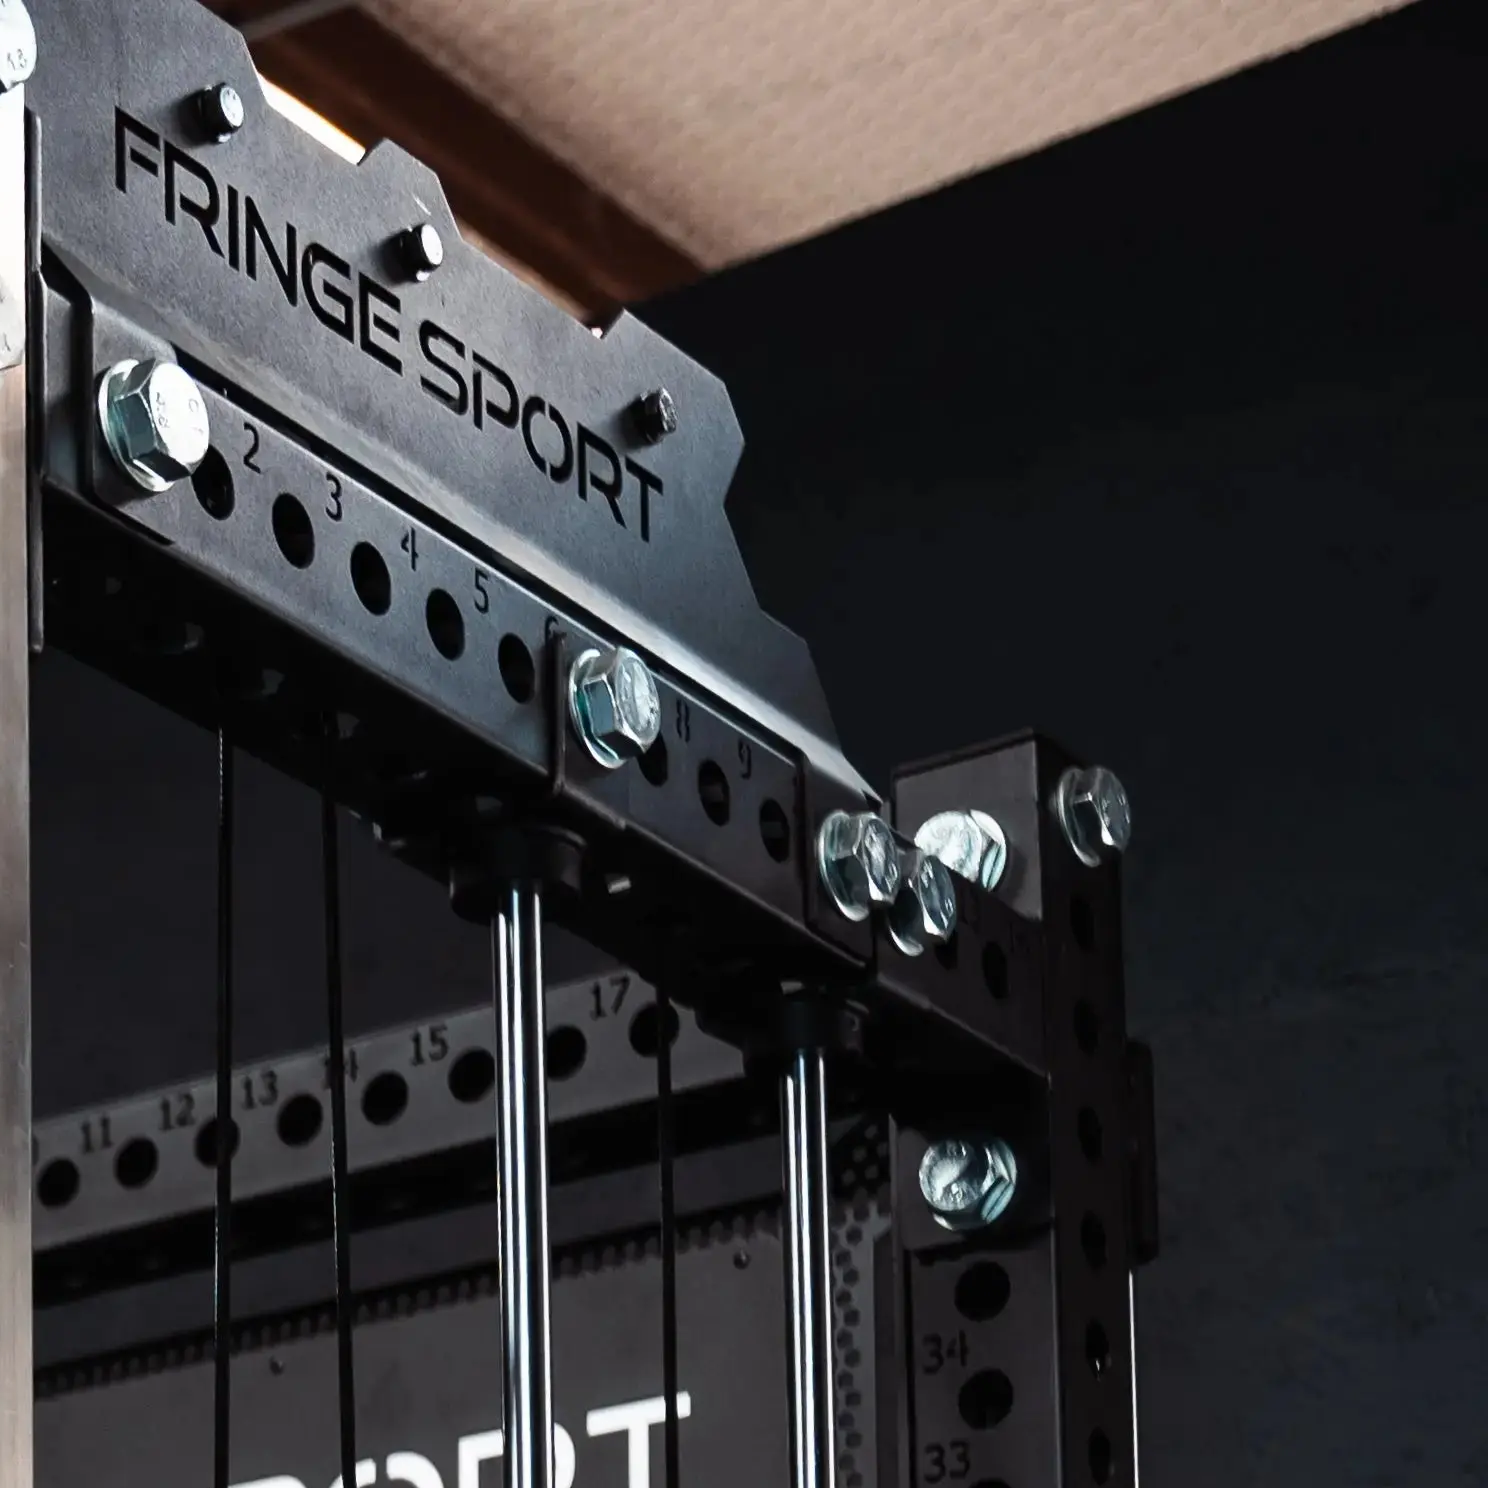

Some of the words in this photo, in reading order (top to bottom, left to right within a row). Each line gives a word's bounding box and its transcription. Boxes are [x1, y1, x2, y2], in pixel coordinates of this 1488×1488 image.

[115, 107, 403, 374] FRINGE
[419, 324, 663, 541] SPORT
[244, 424, 261, 474] 2
[325, 477, 343, 522] 3
[400, 528, 419, 571] 4
[475, 569, 489, 613] 5
[589, 976, 630, 1019] 17
[410, 1026, 448, 1066] 15
[159, 1093, 195, 1131] 12
[240, 1072, 278, 1110] 13
[79, 1119, 112, 1154] 11
[922, 1332, 969, 1374] 34
[924, 1443, 972, 1483] 33
